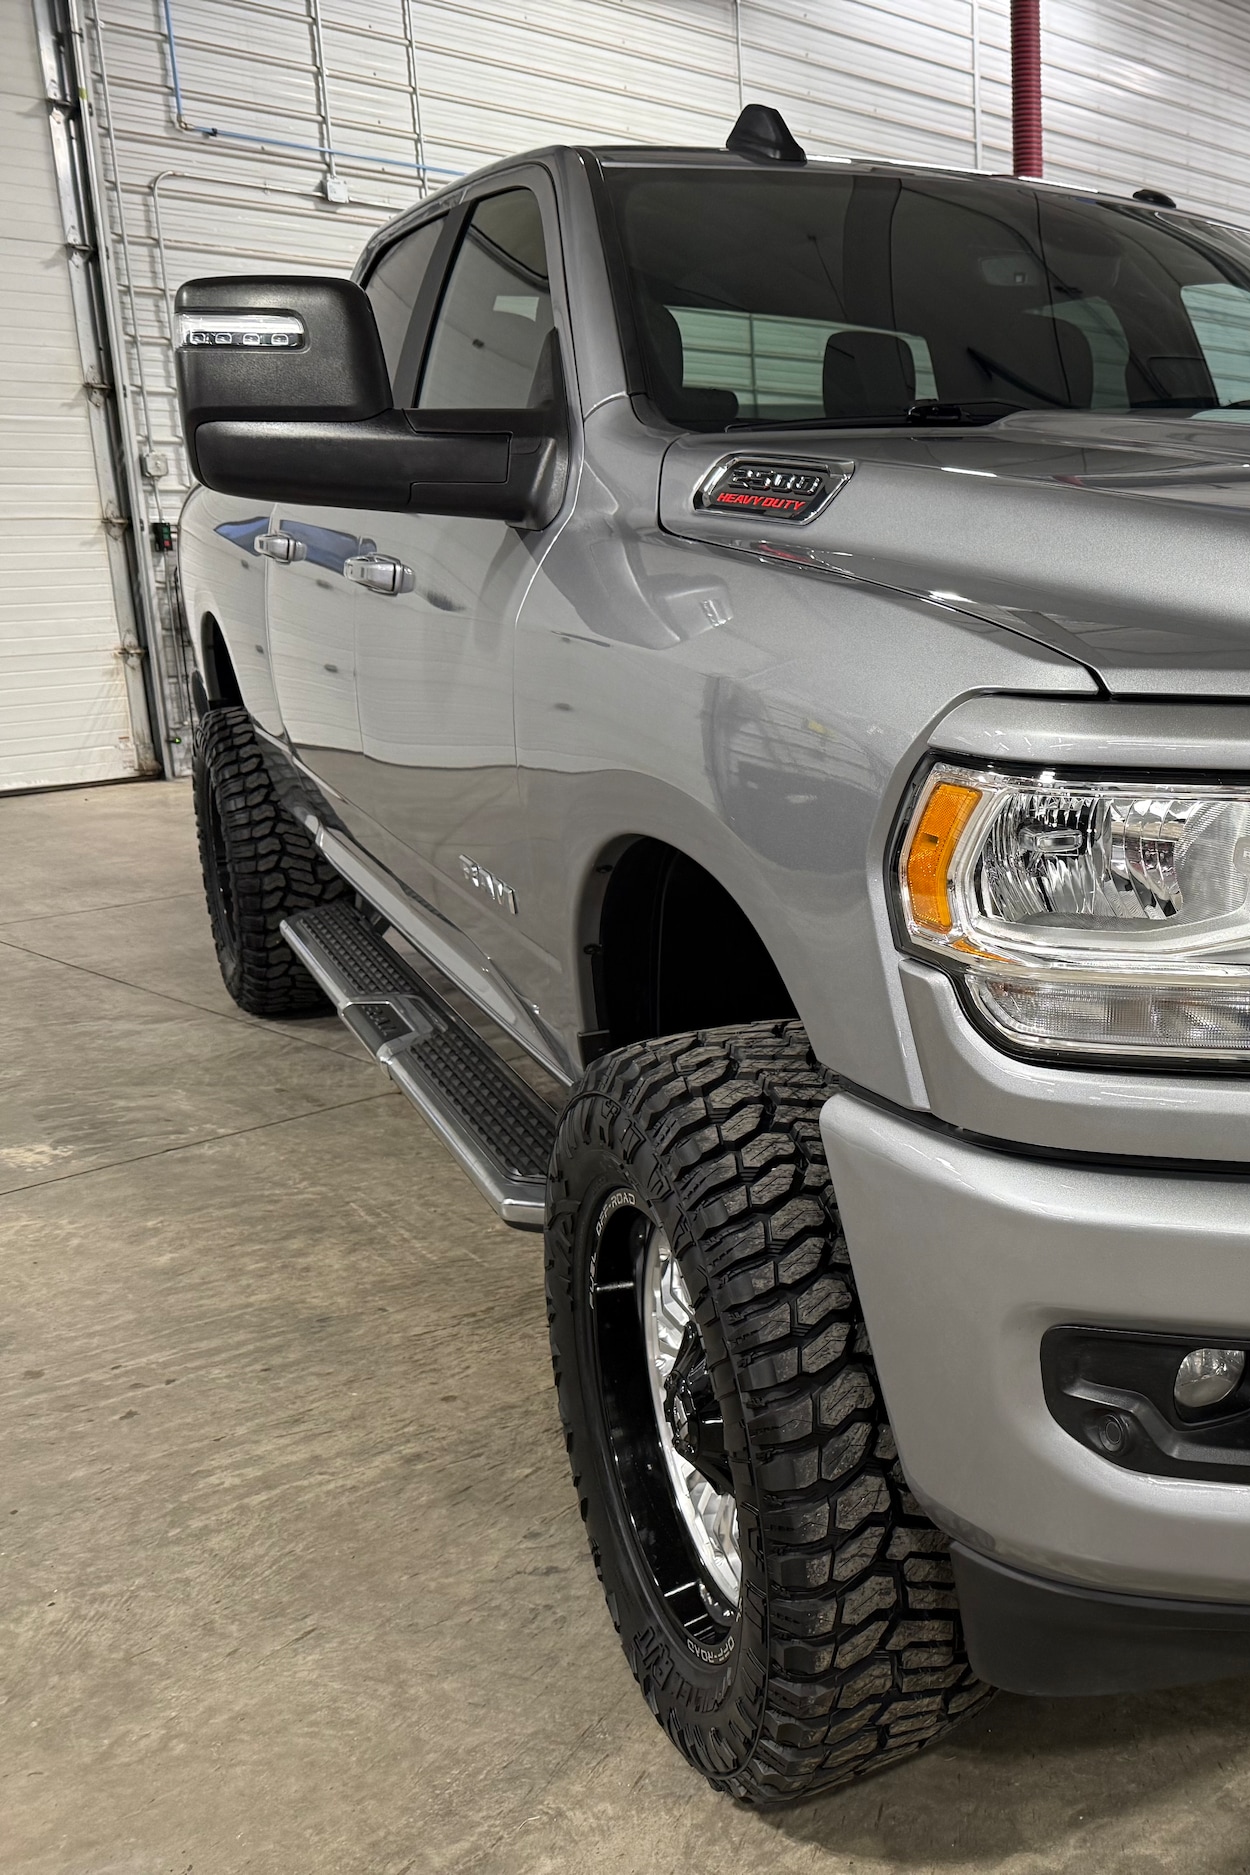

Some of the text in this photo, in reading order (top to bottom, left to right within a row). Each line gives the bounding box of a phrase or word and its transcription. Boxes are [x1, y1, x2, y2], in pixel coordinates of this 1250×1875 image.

[727, 468, 823, 496] 2500
[716, 492, 806, 511] HEAVY DUTY
[459, 854, 518, 915] RAM
[596, 1192, 636, 1236] OFF-ROAD
[687, 1636, 735, 1664] OFF-ROAD
